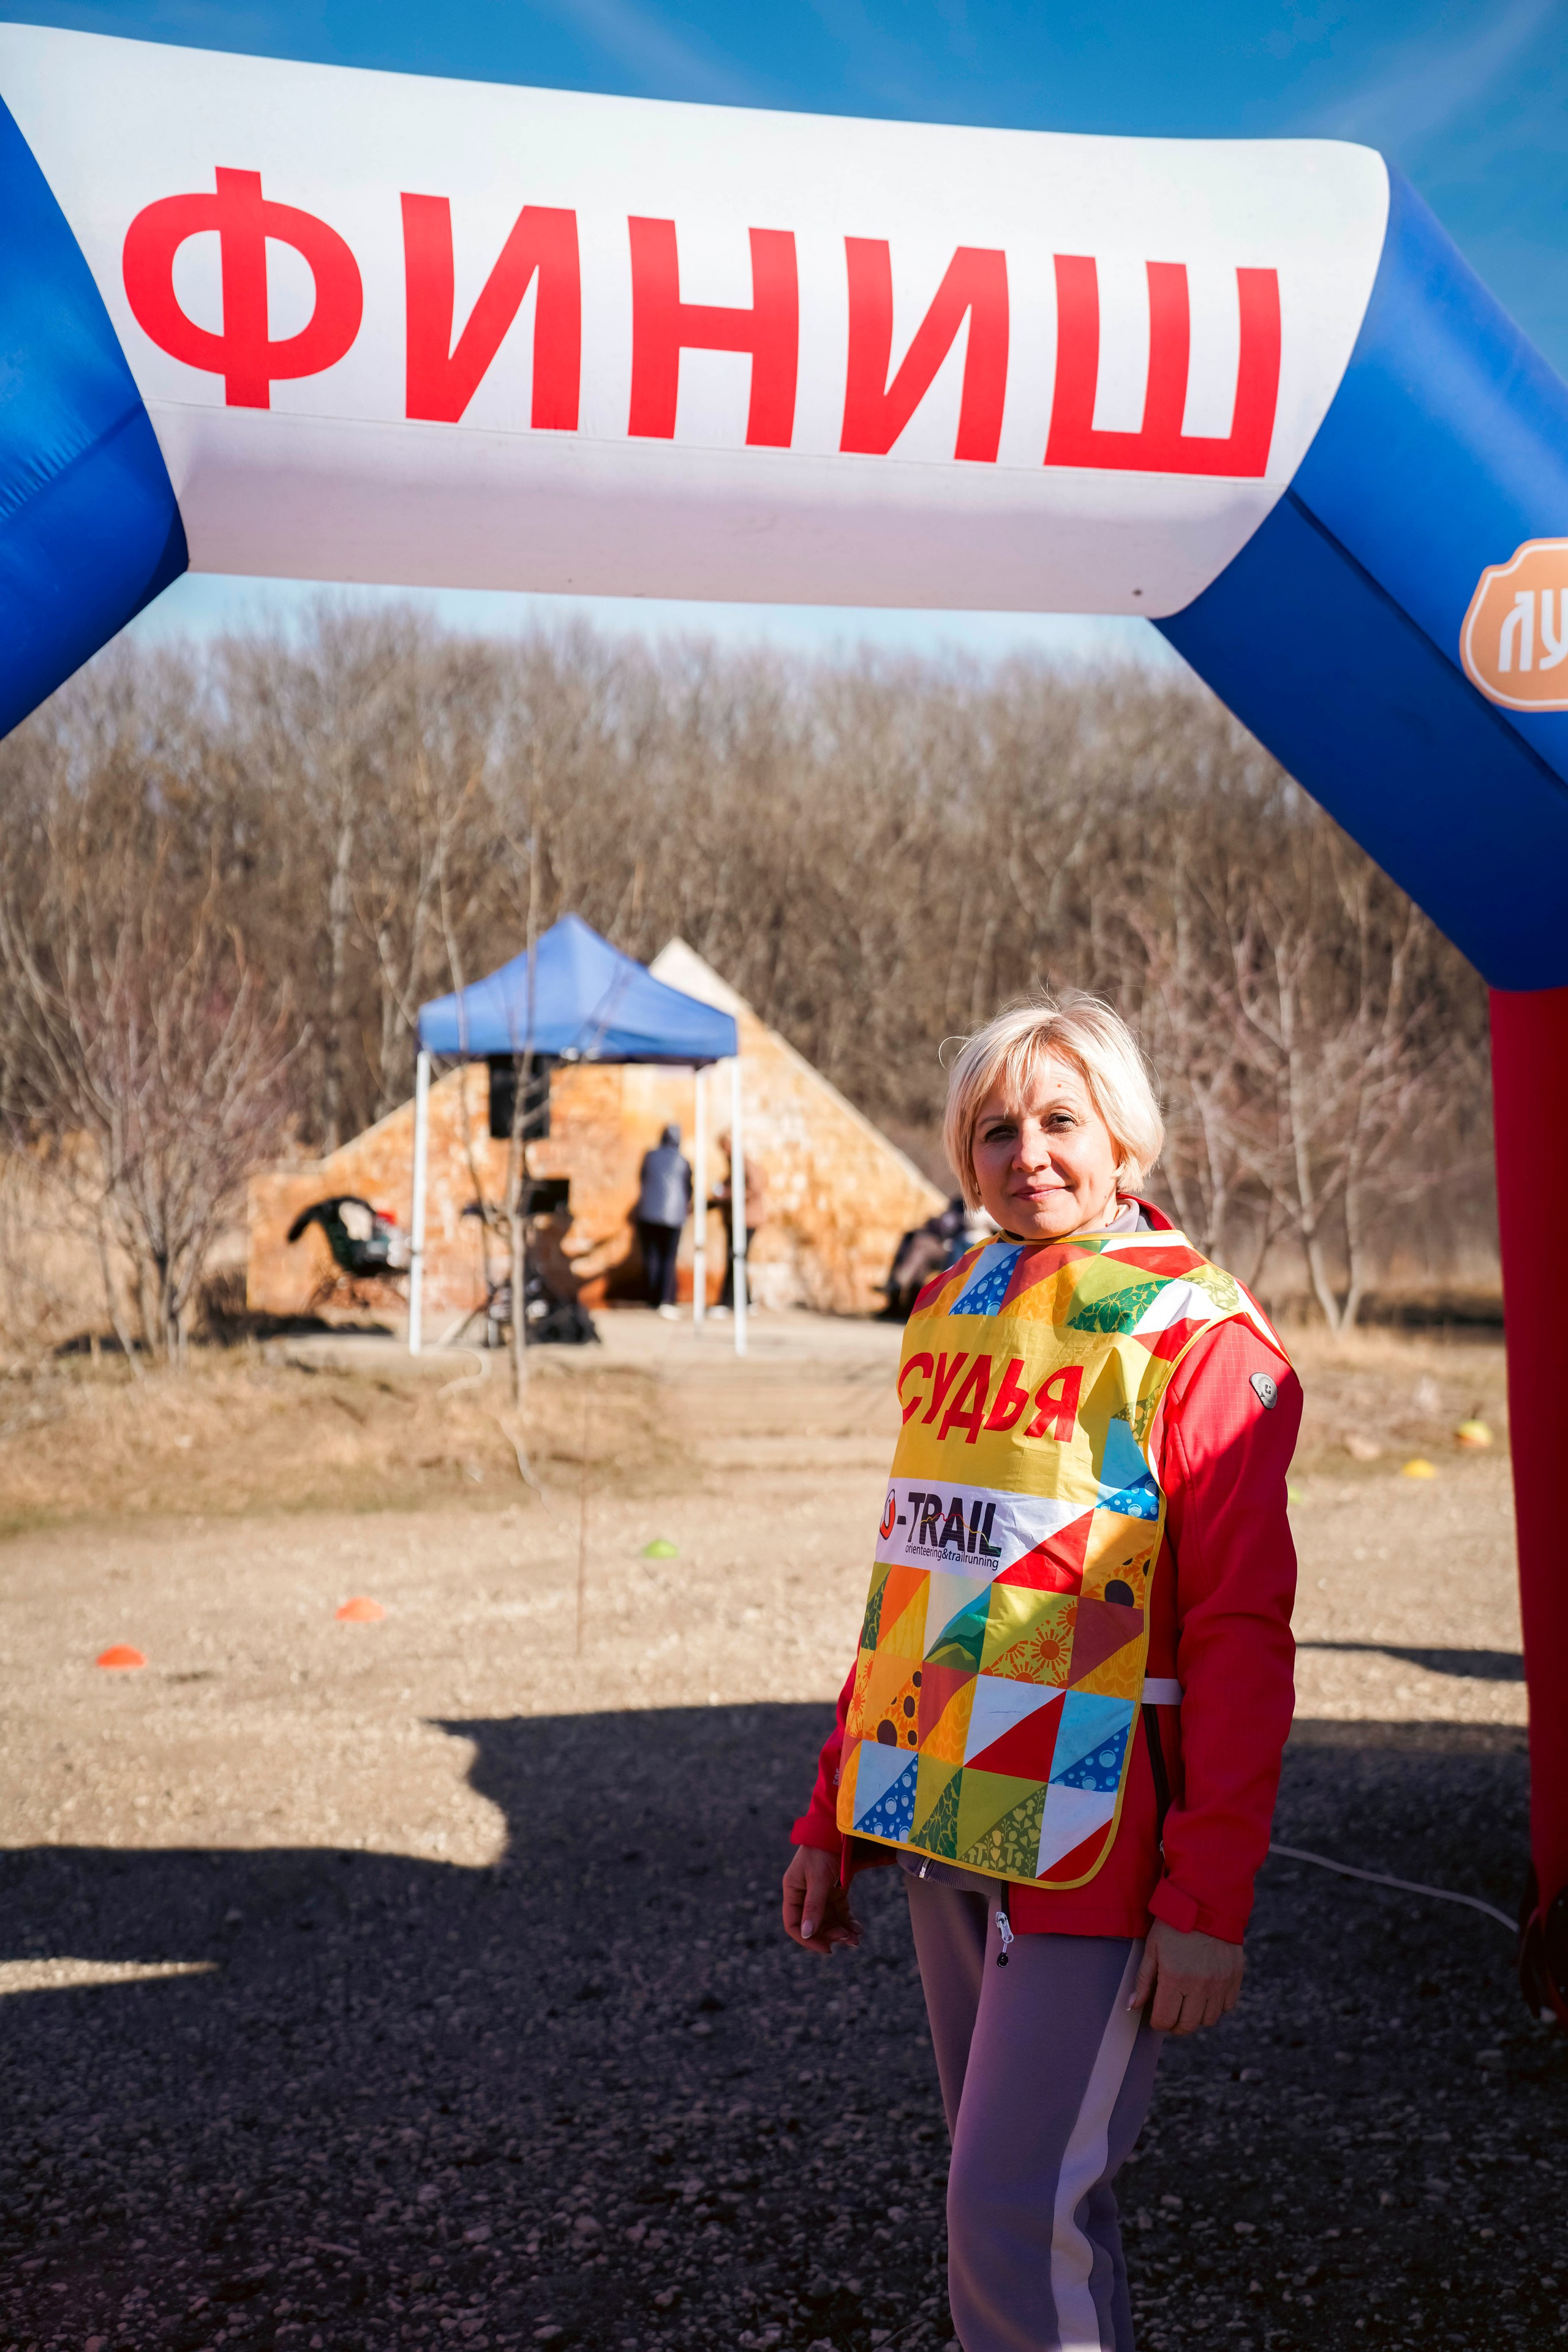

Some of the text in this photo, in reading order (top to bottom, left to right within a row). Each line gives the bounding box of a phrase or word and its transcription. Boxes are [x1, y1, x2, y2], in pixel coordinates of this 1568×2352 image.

[123, 166, 1282, 478] ФИНИШ
[897, 1352, 1084, 1444] СУДЬЯ
[905, 1542, 1000, 1571] orienteering&trailrunning
